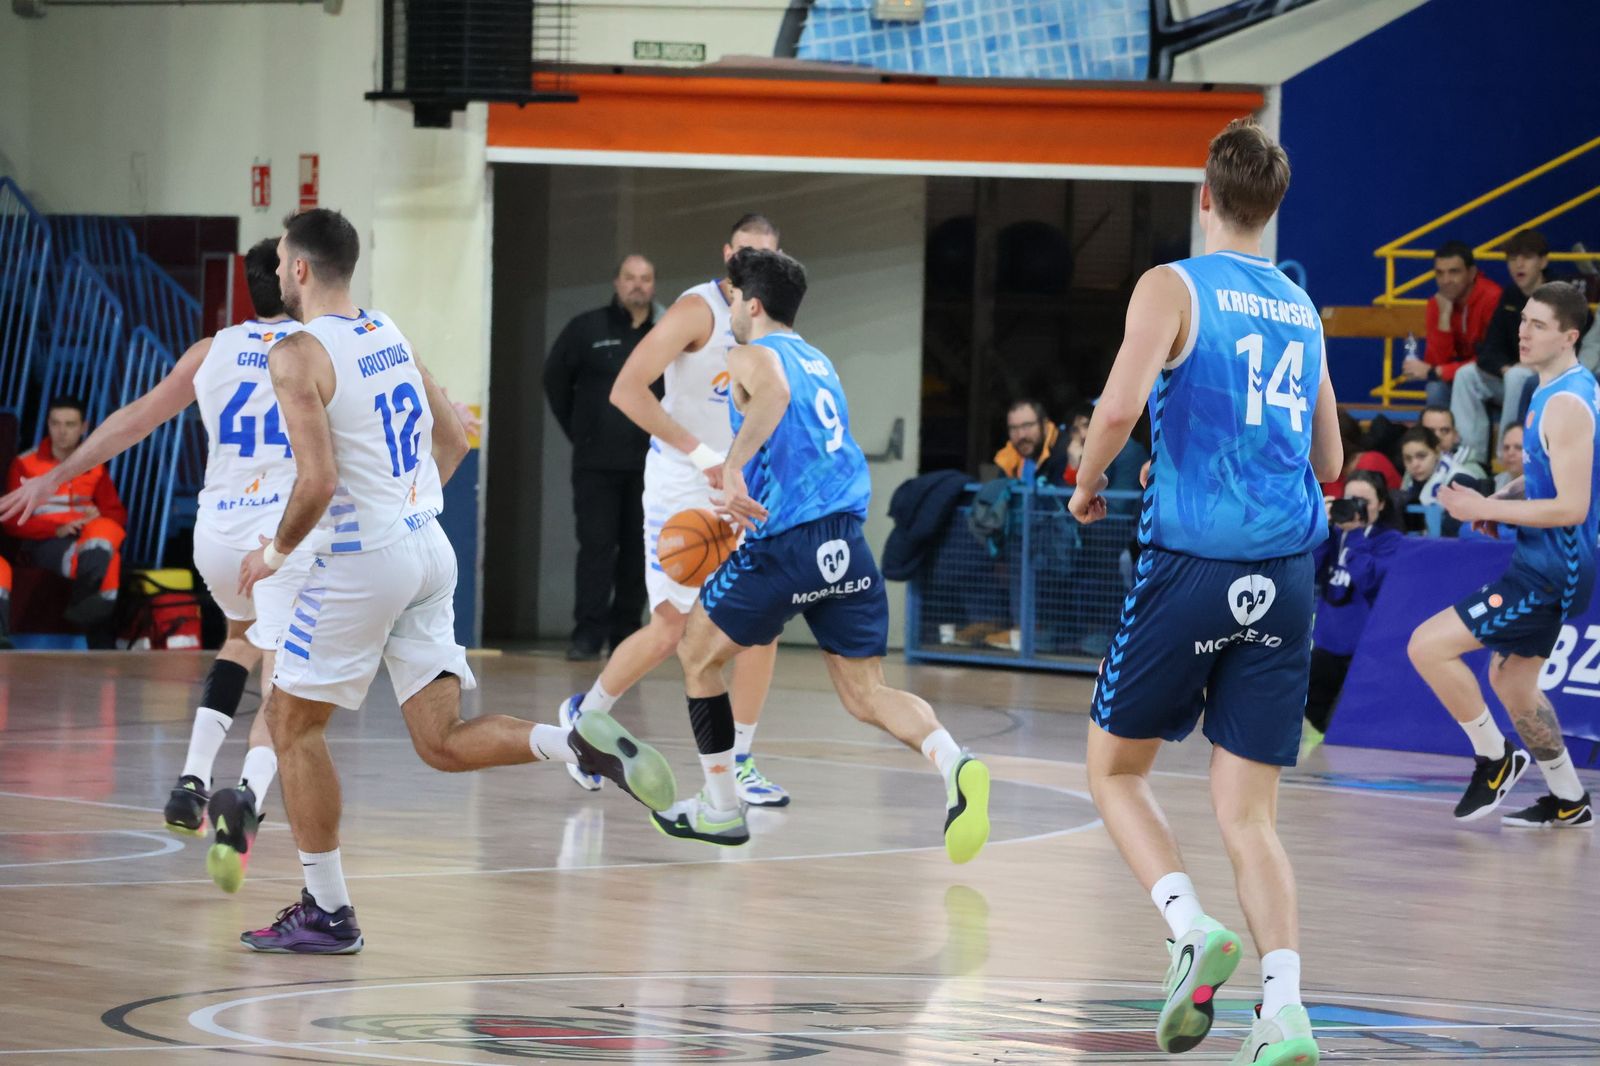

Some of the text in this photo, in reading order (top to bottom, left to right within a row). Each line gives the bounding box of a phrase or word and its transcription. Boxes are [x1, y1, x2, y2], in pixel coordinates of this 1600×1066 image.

[1216, 289, 1316, 330] KRISTENSEN
[358, 343, 409, 378] KRUTOUS
[1236, 334, 1307, 432] 14
[219, 381, 292, 458] 44
[374, 382, 423, 477] 12
[815, 387, 844, 453] 9
